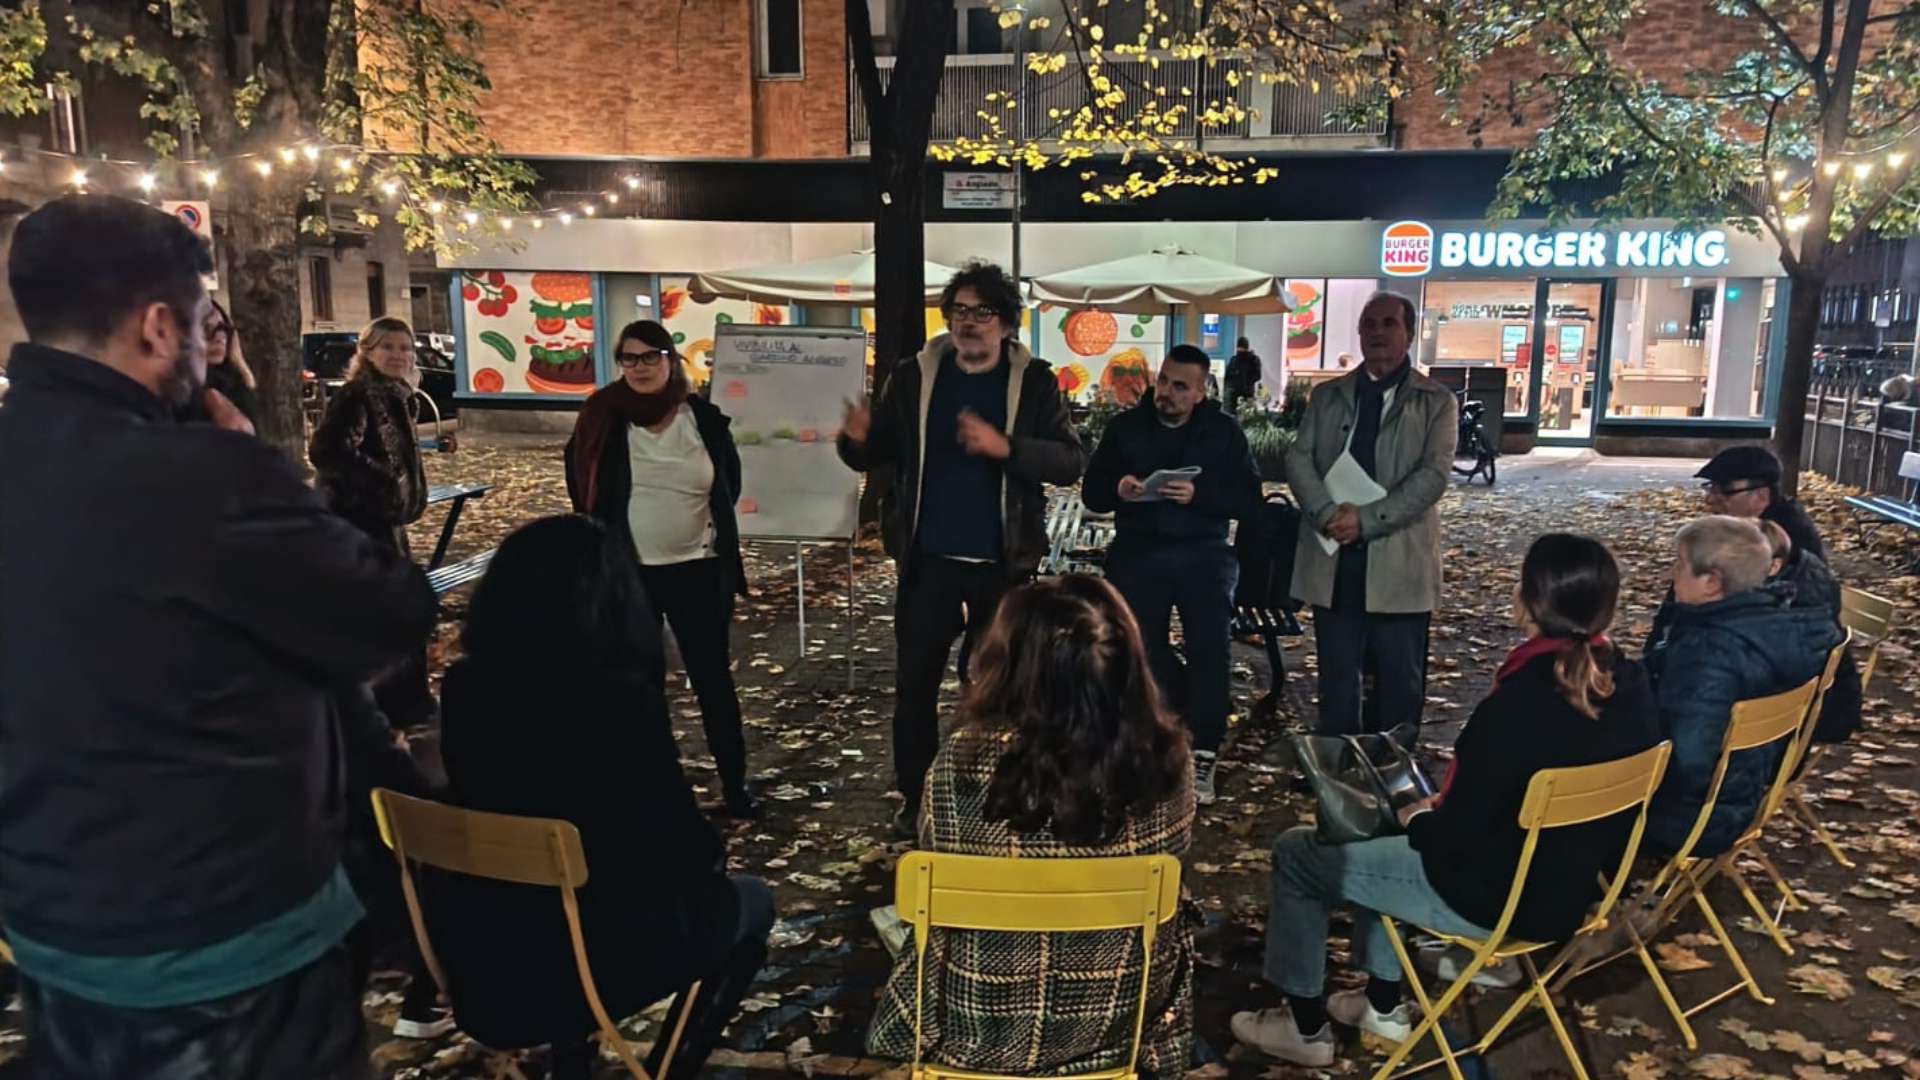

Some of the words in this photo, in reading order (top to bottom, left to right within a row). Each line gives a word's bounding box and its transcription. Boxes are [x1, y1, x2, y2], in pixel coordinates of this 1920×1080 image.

[1385, 239, 1429, 249] BURGER
[1440, 232, 1606, 267] BURGER
[1385, 250, 1429, 263] KING
